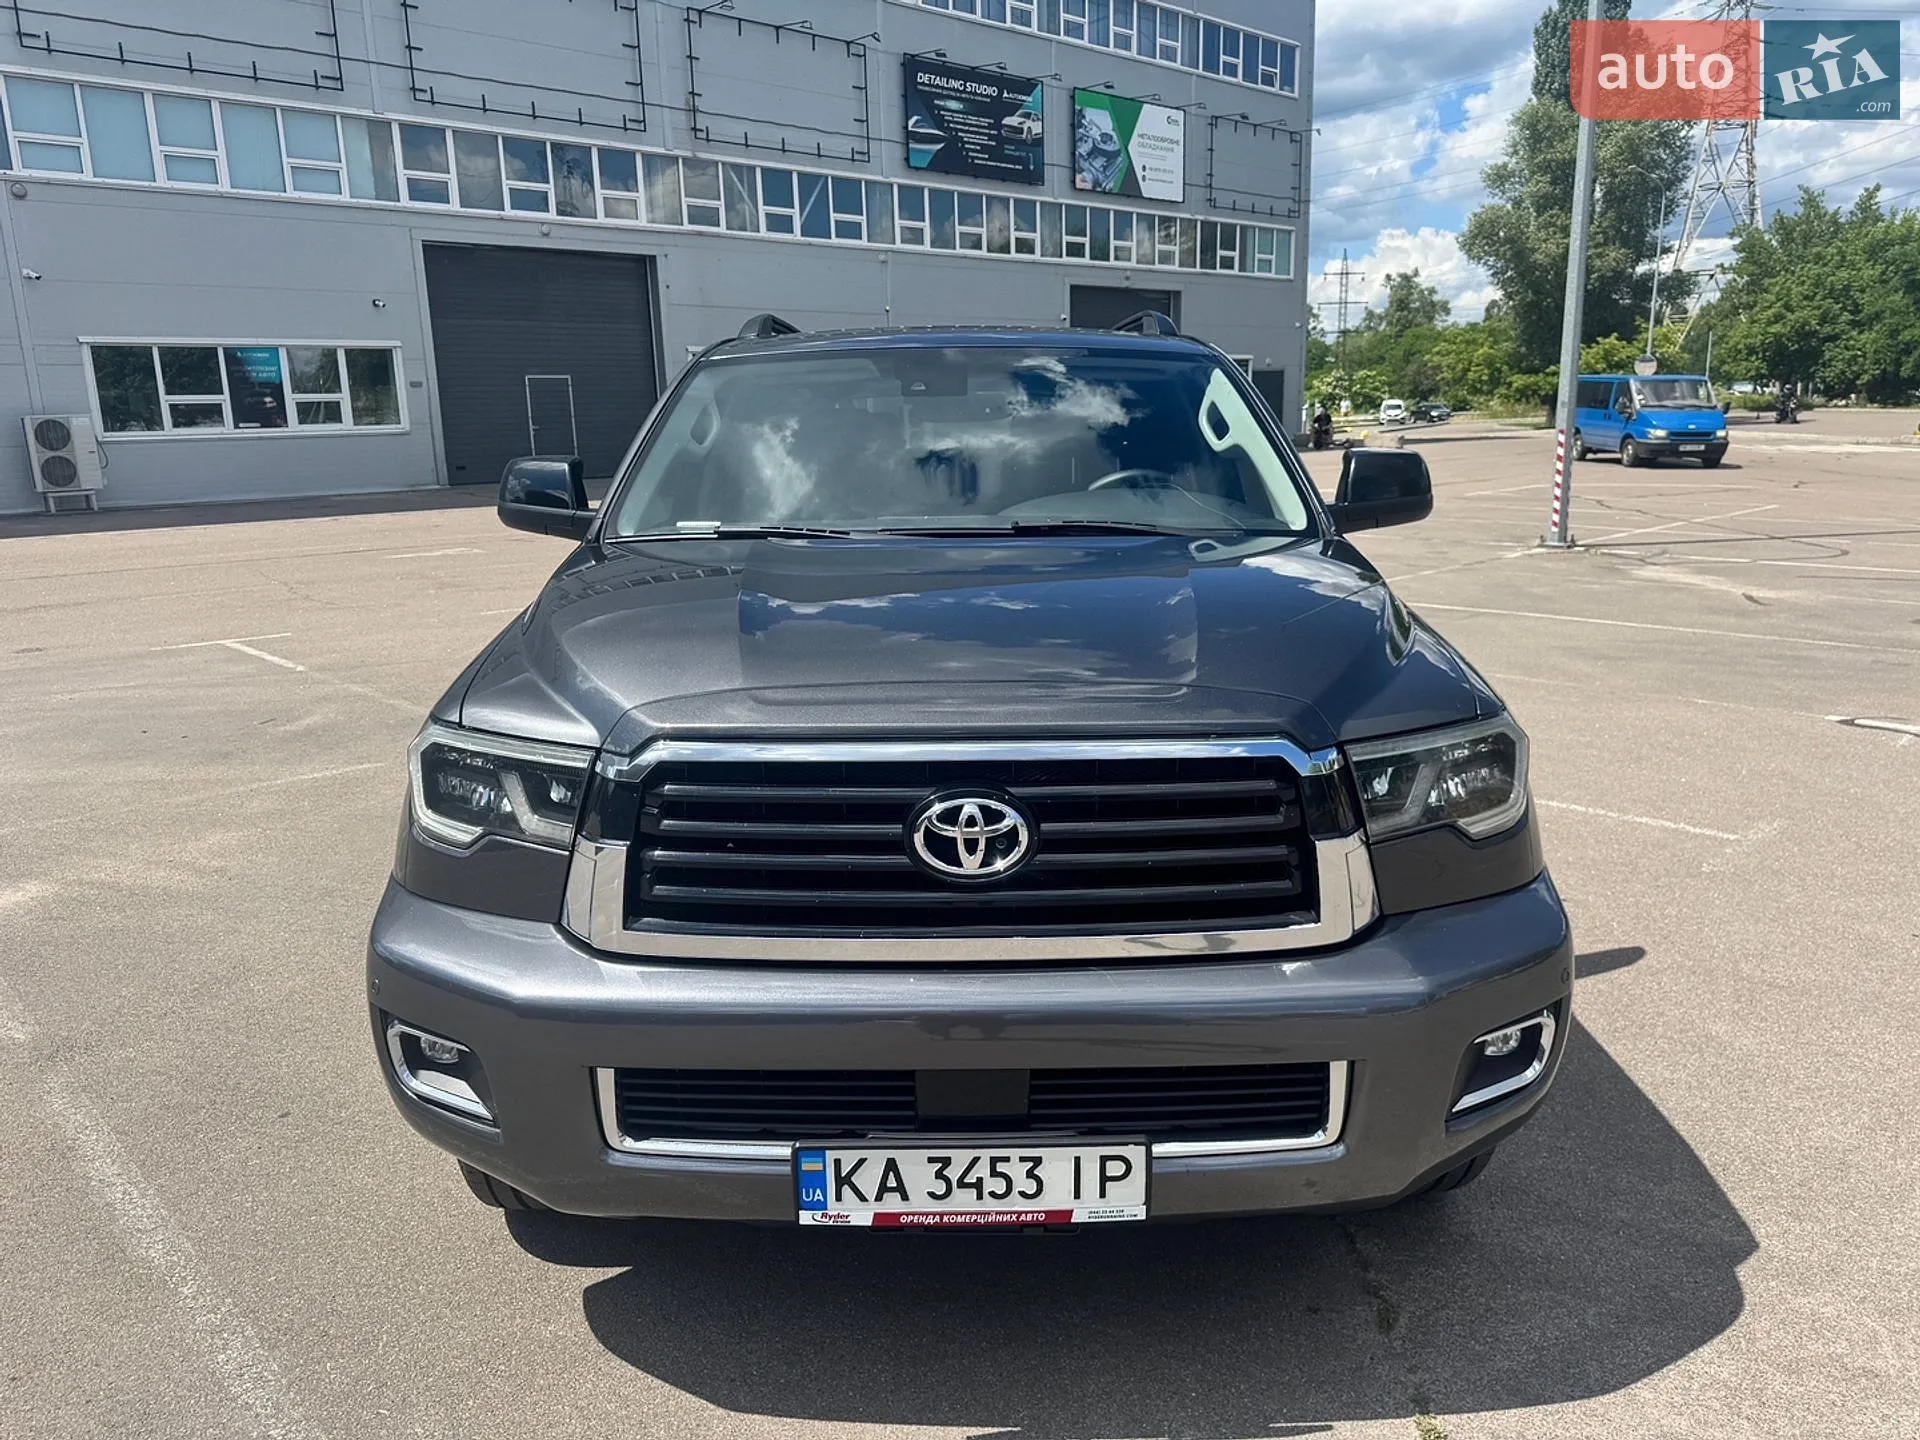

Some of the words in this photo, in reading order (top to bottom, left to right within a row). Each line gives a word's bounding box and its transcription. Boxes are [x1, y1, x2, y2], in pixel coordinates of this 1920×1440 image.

[917, 72, 965, 91] DETAILING
[965, 82, 998, 96] STUDIO
[833, 1157, 910, 1202] KA
[926, 1156, 1043, 1201] 3453
[1073, 1155, 1133, 1200] IP
[802, 1188, 824, 1202] UA
[820, 1212, 850, 1221] Ryder
[899, 1214, 940, 1225] ОРЕНДА
[942, 1211, 1018, 1224] КОМЕРЦІЙНИХ
[1019, 1212, 1046, 1222] АВТО
